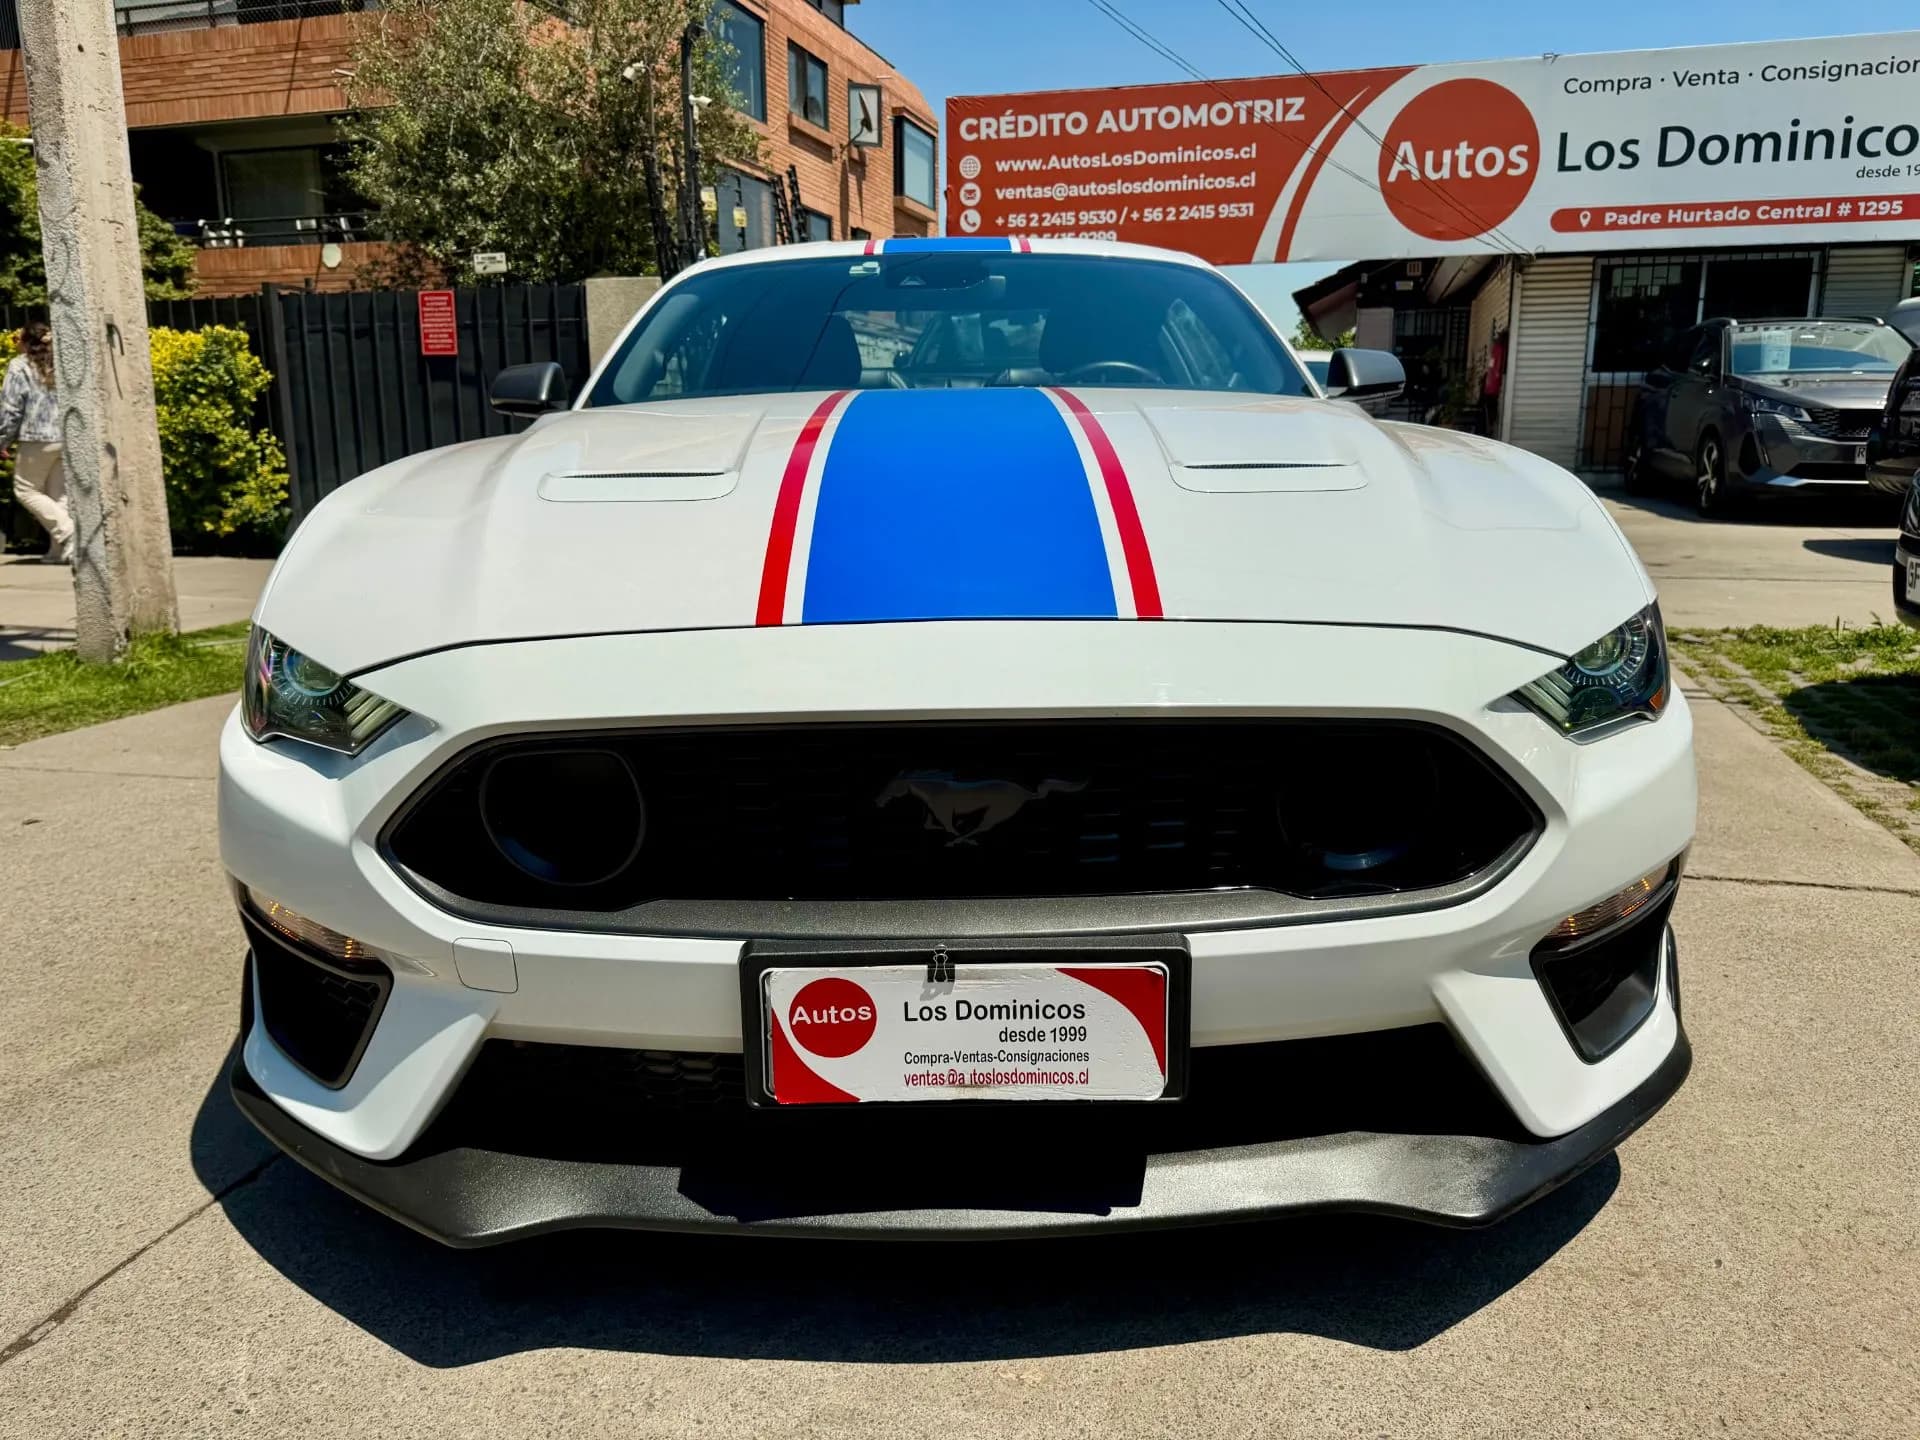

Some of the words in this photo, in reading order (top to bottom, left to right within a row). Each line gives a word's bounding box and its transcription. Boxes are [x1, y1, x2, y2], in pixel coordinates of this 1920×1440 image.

[1564, 76, 1652, 95] Compra
[1673, 70, 1740, 87] Venta
[959, 109, 1089, 142] CRÉDITO
[1095, 97, 1305, 134] AUTOMOTRIZ
[995, 143, 1257, 173] www.AutosLosDominicos.cl
[1387, 140, 1529, 183] Autos
[1557, 131, 1640, 172] Los
[1856, 165, 1900, 178] desde
[995, 171, 1256, 200] ventas@autoslosdominicos.cl
[1008, 213, 1027, 228] 56
[1029, 213, 1039, 227] 2
[1041, 211, 1075, 226] 2415
[1078, 209, 1117, 225] 9530
[1143, 208, 1163, 222] 56
[1166, 207, 1176, 221] 2
[1179, 205, 1215, 220] 2415
[1218, 203, 1254, 219] 9531
[1604, 211, 1661, 226] Padre
[1668, 206, 1750, 223] Hurtado
[1757, 202, 1830, 219] Central
[1858, 200, 1903, 216] 1295
[791, 1004, 872, 1025] Autos
[904, 1001, 947, 1022] Los
[955, 999, 1086, 1020] Dominicos
[999, 1027, 1046, 1042] desde
[1050, 1026, 1087, 1043] 1999
[904, 1049, 1090, 1067] Compra-Ventas-Consignaciones
